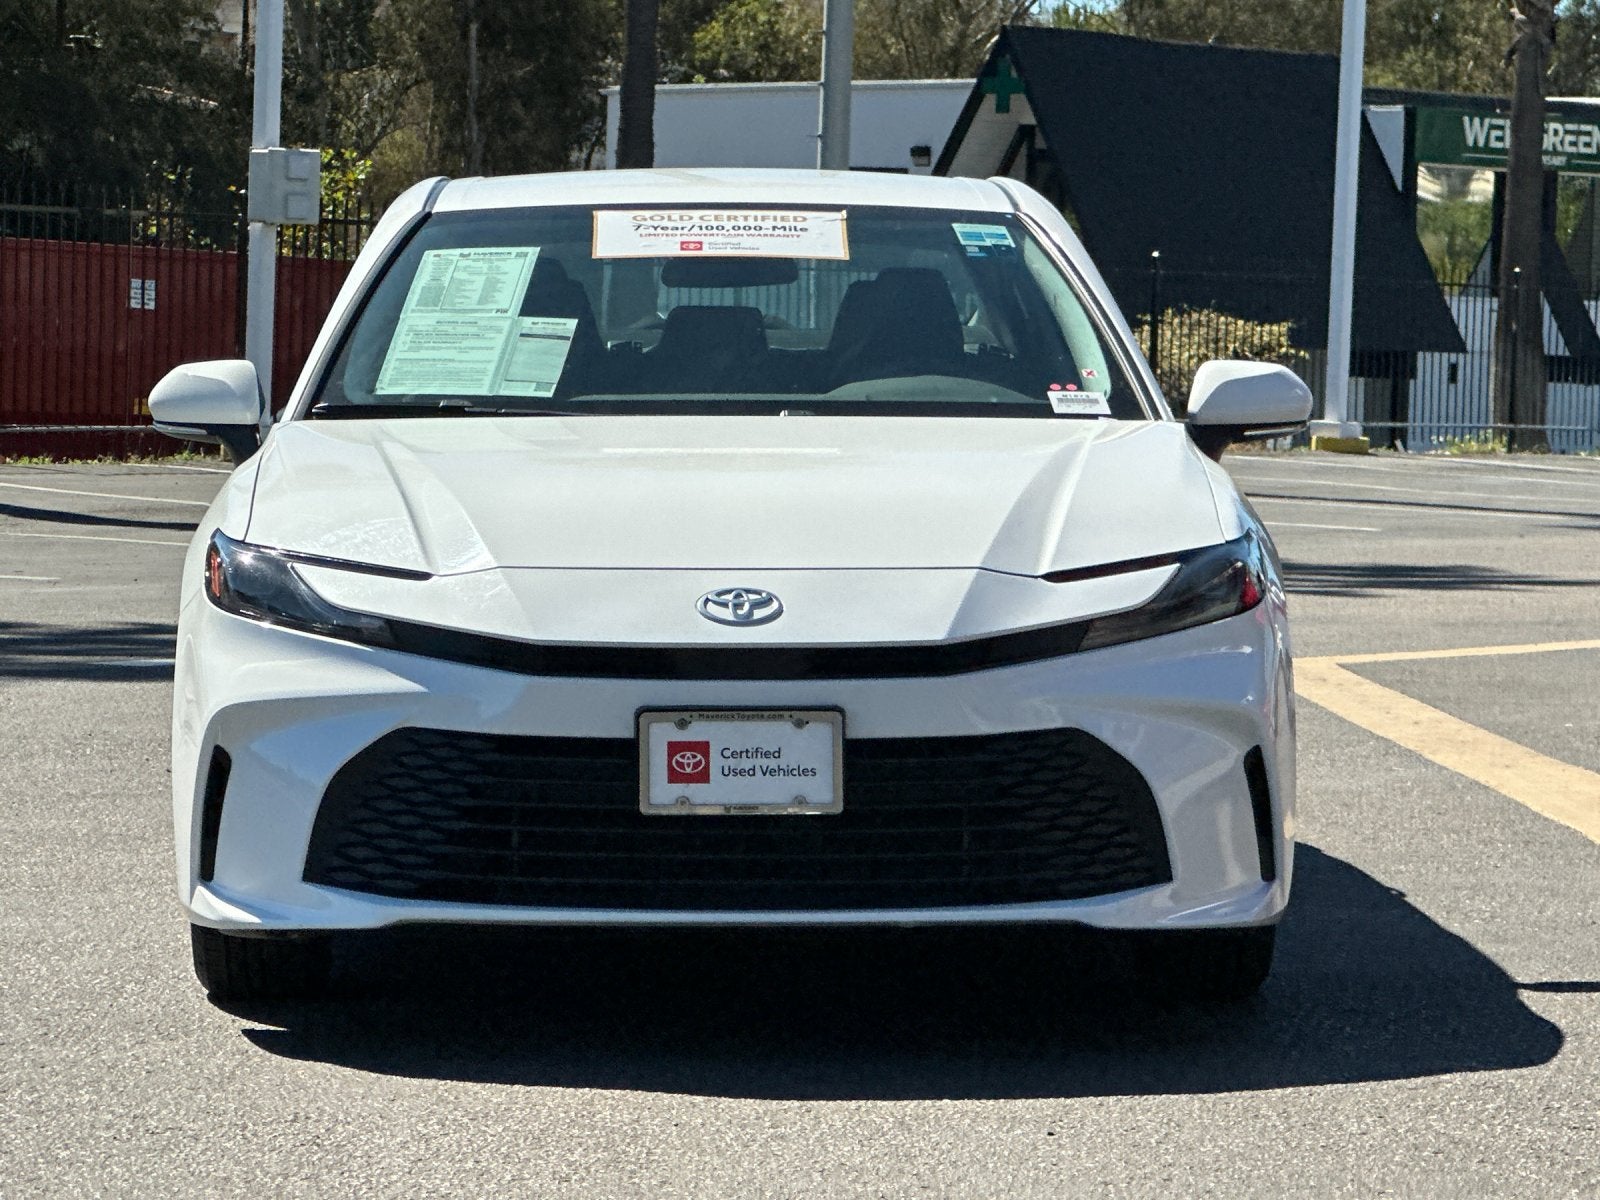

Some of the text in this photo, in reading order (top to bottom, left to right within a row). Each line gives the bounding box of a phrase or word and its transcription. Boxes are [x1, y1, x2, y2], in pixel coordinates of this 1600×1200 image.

[632, 214, 808, 223] GOLD CERTIFIED
[632, 224, 809, 233] 7-Year/100,000-Mile
[698, 712, 784, 720] MaverickToyota.com
[720, 747, 781, 760] Certified
[721, 764, 817, 778] Used Vehicles
